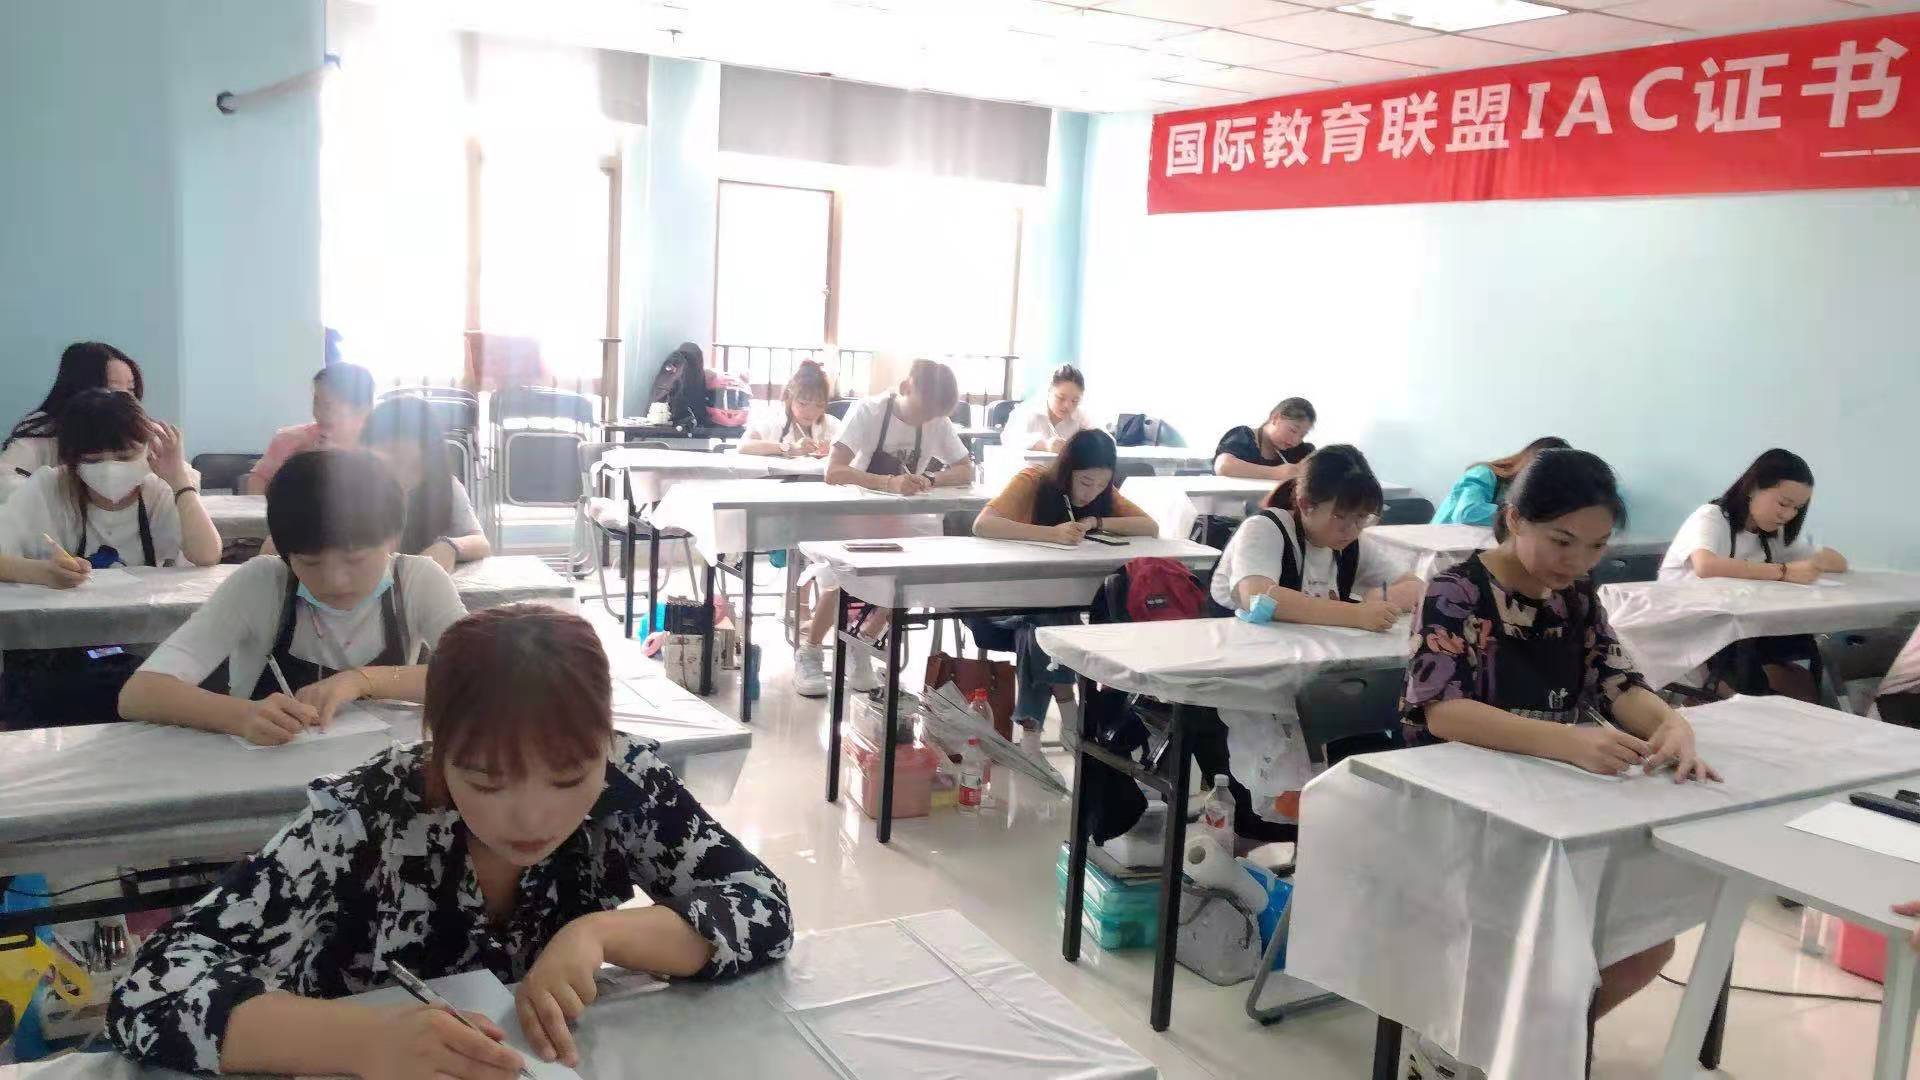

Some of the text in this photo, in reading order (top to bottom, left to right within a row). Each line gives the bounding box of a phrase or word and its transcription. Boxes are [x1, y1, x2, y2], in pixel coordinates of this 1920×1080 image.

[1165, 37, 1909, 177] 国际教育联盟IAC证书
